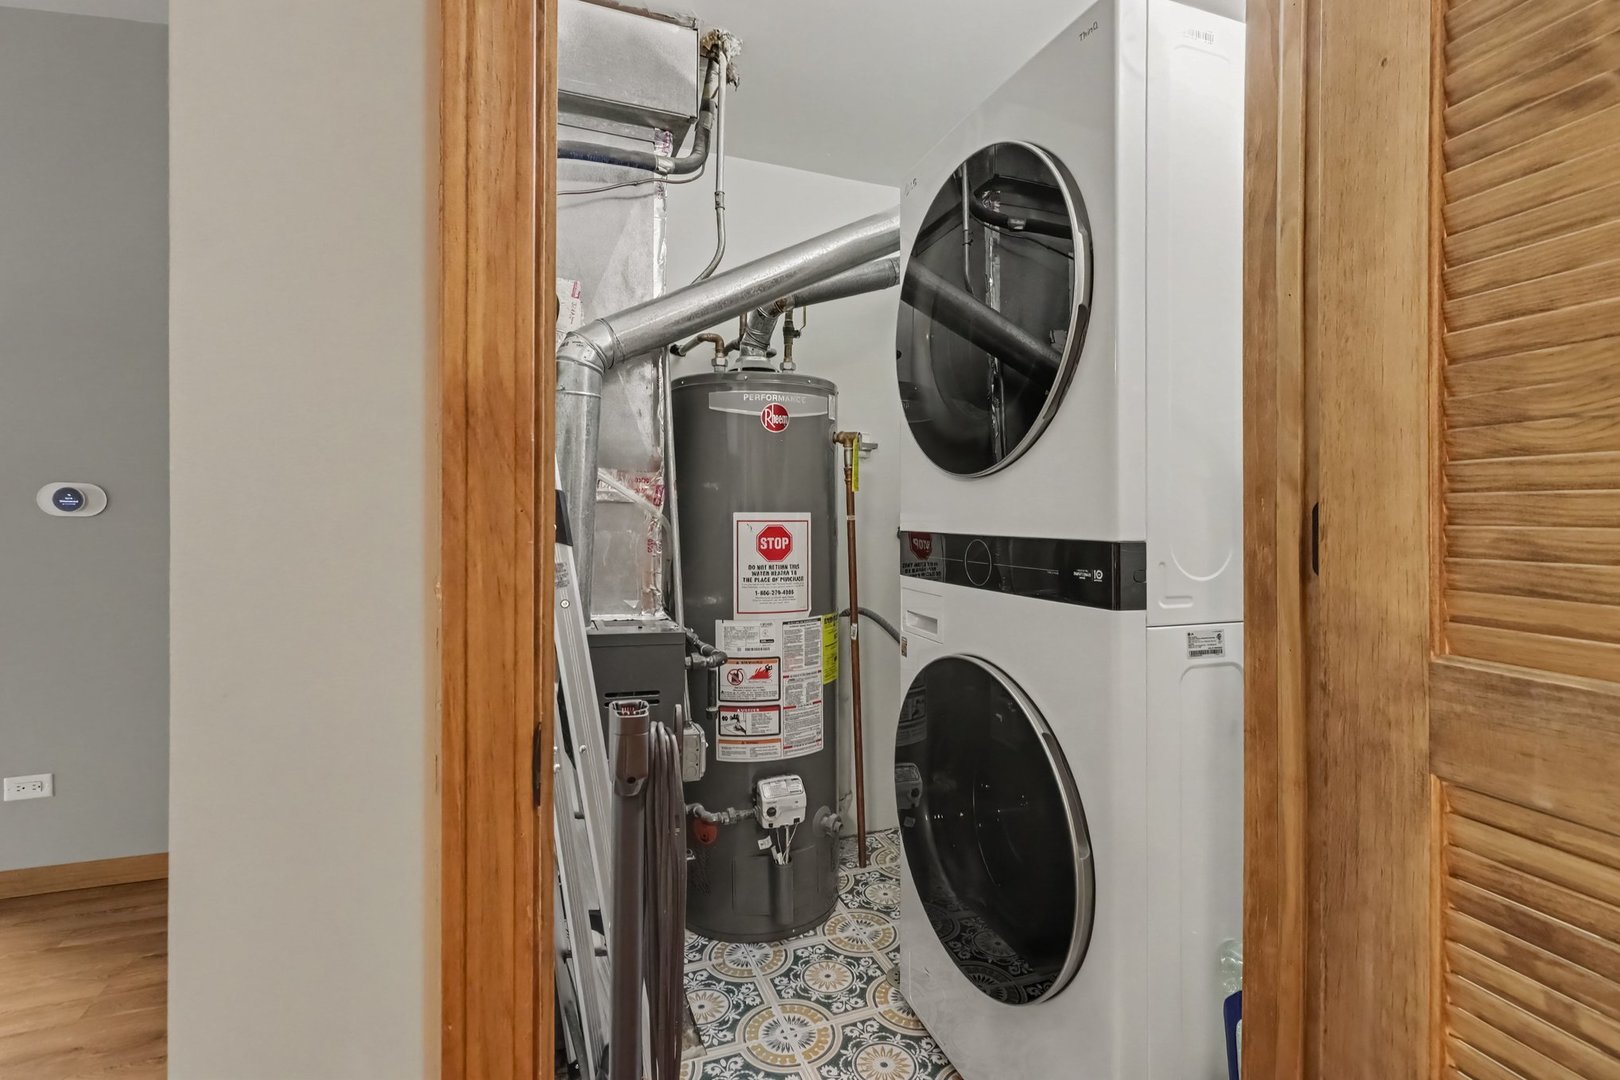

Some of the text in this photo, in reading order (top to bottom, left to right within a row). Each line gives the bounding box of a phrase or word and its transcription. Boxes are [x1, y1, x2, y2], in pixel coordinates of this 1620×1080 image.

[743, 393, 807, 404] PERFORMANCE
[764, 404, 788, 428] Rheem
[760, 537, 789, 550] STOP
